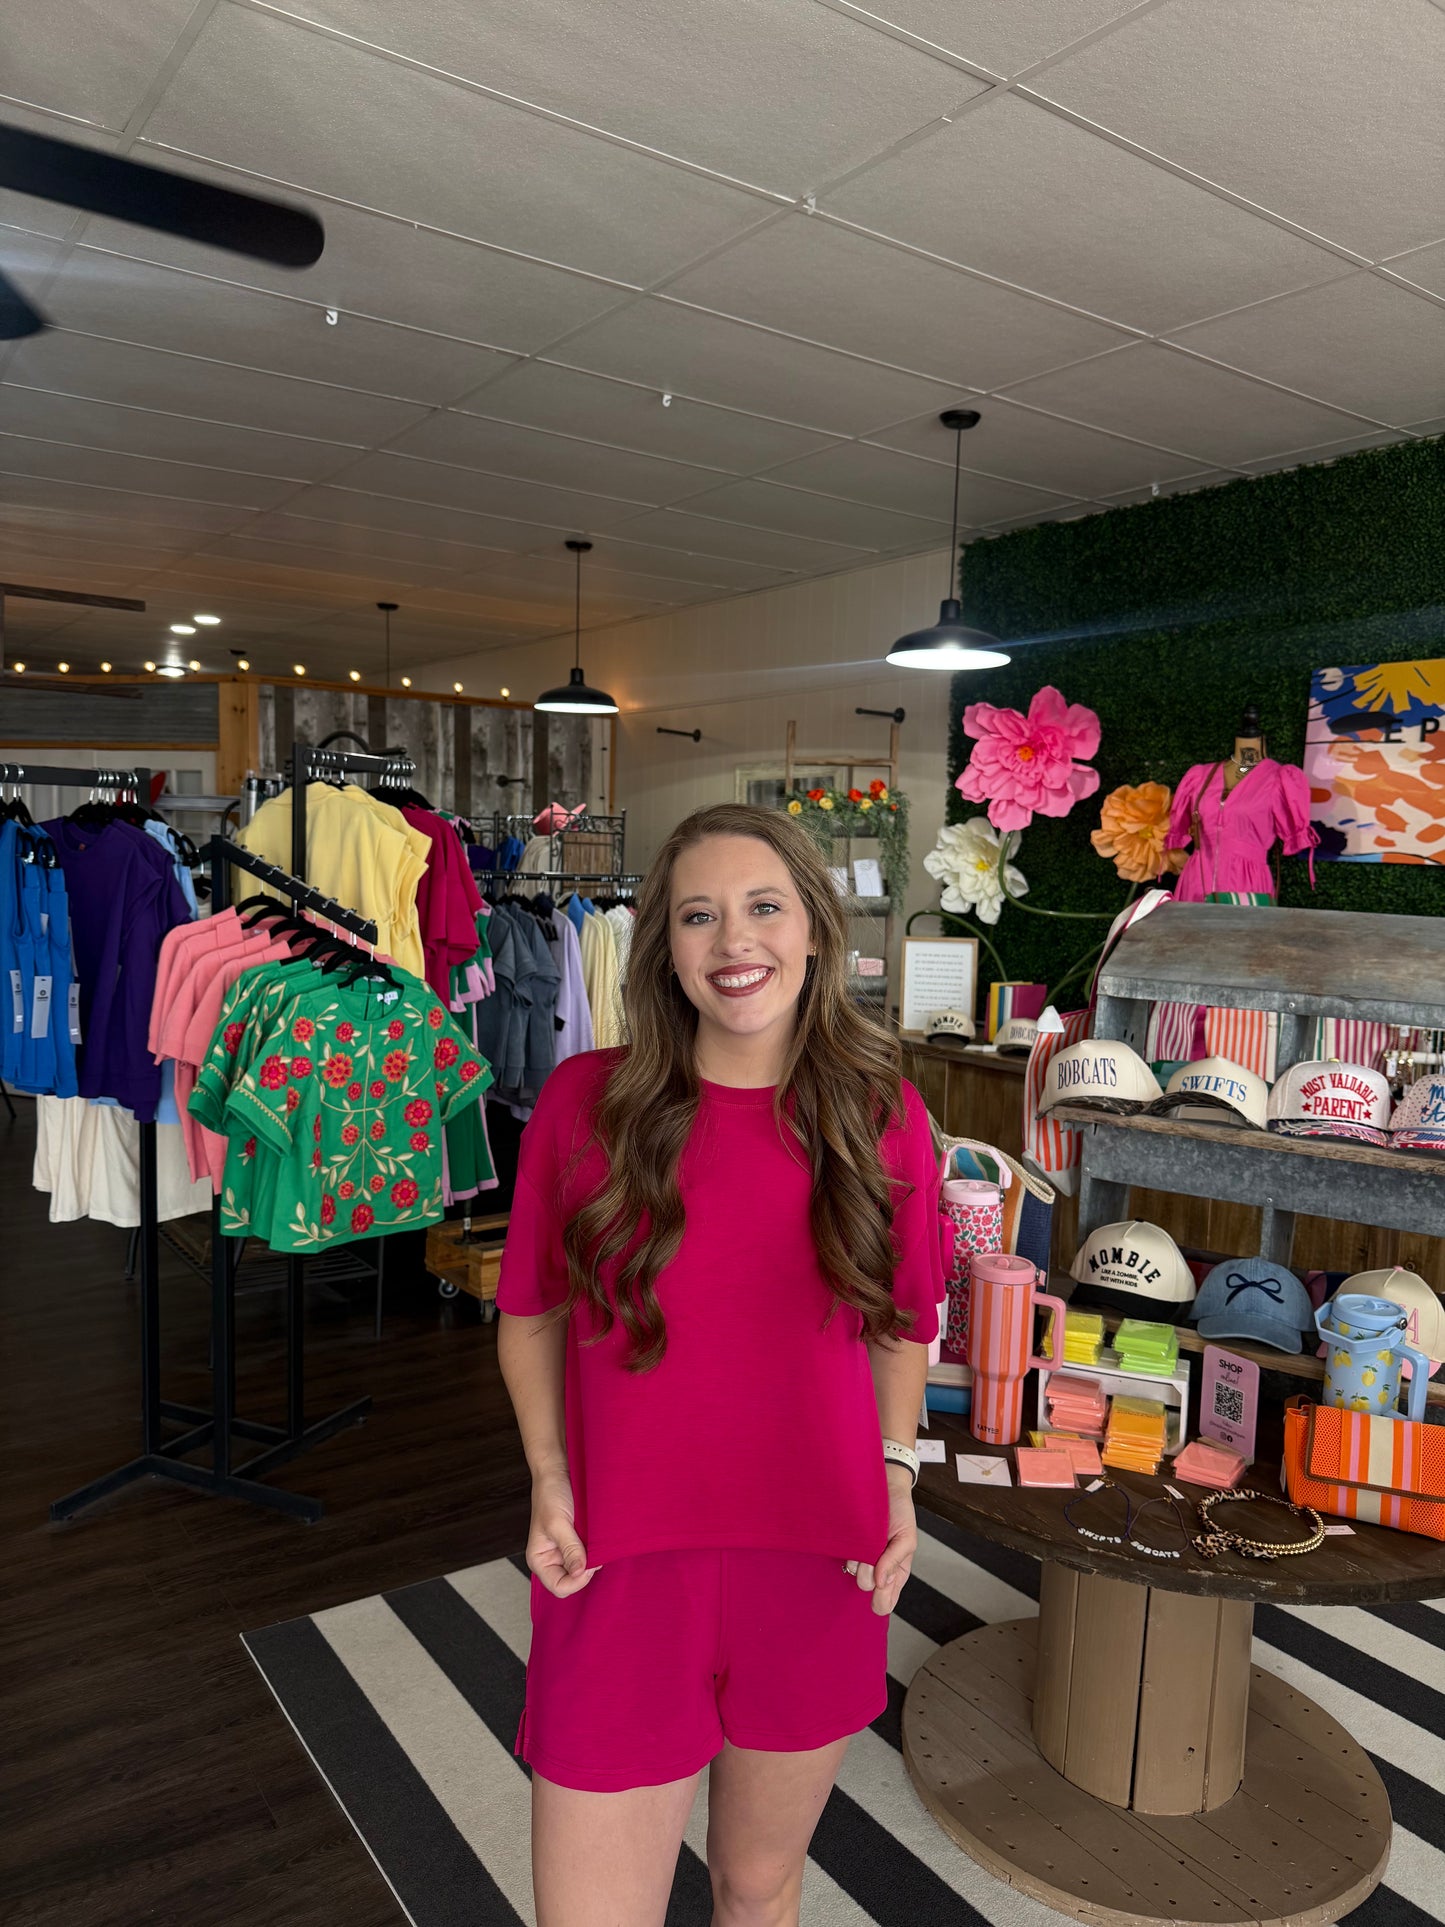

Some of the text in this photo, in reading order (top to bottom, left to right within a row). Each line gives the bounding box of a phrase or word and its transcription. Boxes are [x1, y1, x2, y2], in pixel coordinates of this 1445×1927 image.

[1057, 1057, 1117, 1090] BOBCATS
[1178, 1074, 1248, 1103] SWIFTS
[1299, 1072, 1378, 1107] MOST VALUABLE
[1312, 1096, 1364, 1120] PARENT
[1089, 1246, 1161, 1283] MOMBIE
[1110, 1277, 1124, 1285] WITH
[1124, 1279, 1138, 1287] KIDS
[1218, 1358, 1243, 1374] SHOP
[1130, 1540, 1180, 1558] BOBCATS
